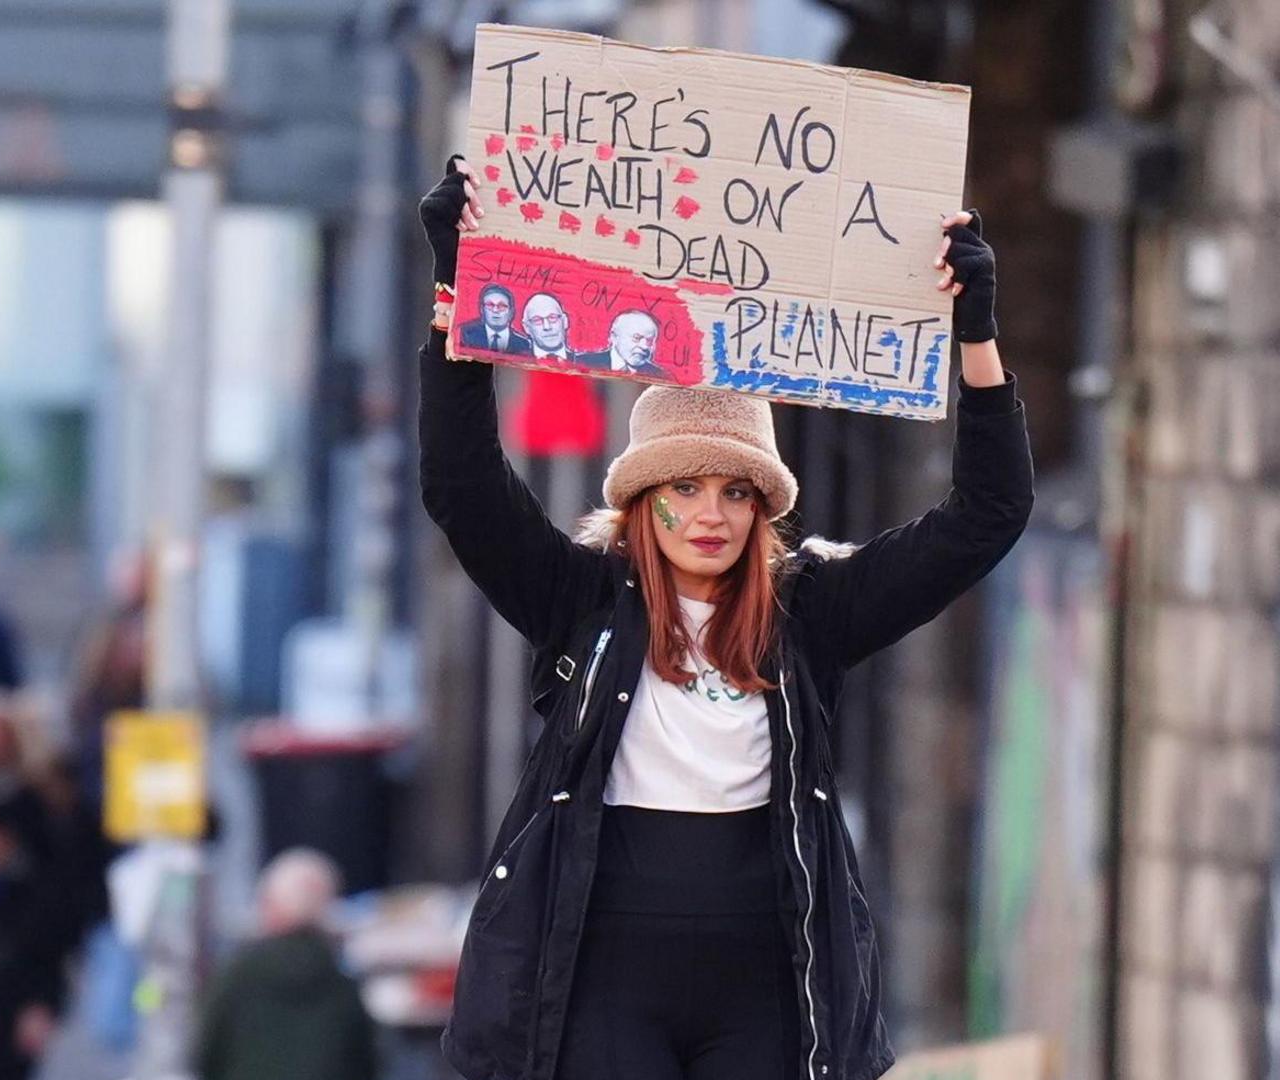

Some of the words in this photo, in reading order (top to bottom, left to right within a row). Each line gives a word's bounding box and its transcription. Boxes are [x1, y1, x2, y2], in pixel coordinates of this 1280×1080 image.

[487, 51, 712, 158] THERE'S
[755, 105, 837, 174] NO
[506, 148, 663, 221] WEALTH
[722, 177, 804, 235] ON
[842, 180, 900, 245] A
[469, 249, 572, 292] SHAME
[580, 279, 623, 313] ON
[636, 223, 772, 292] DEAD
[724, 297, 942, 386] PLANET
